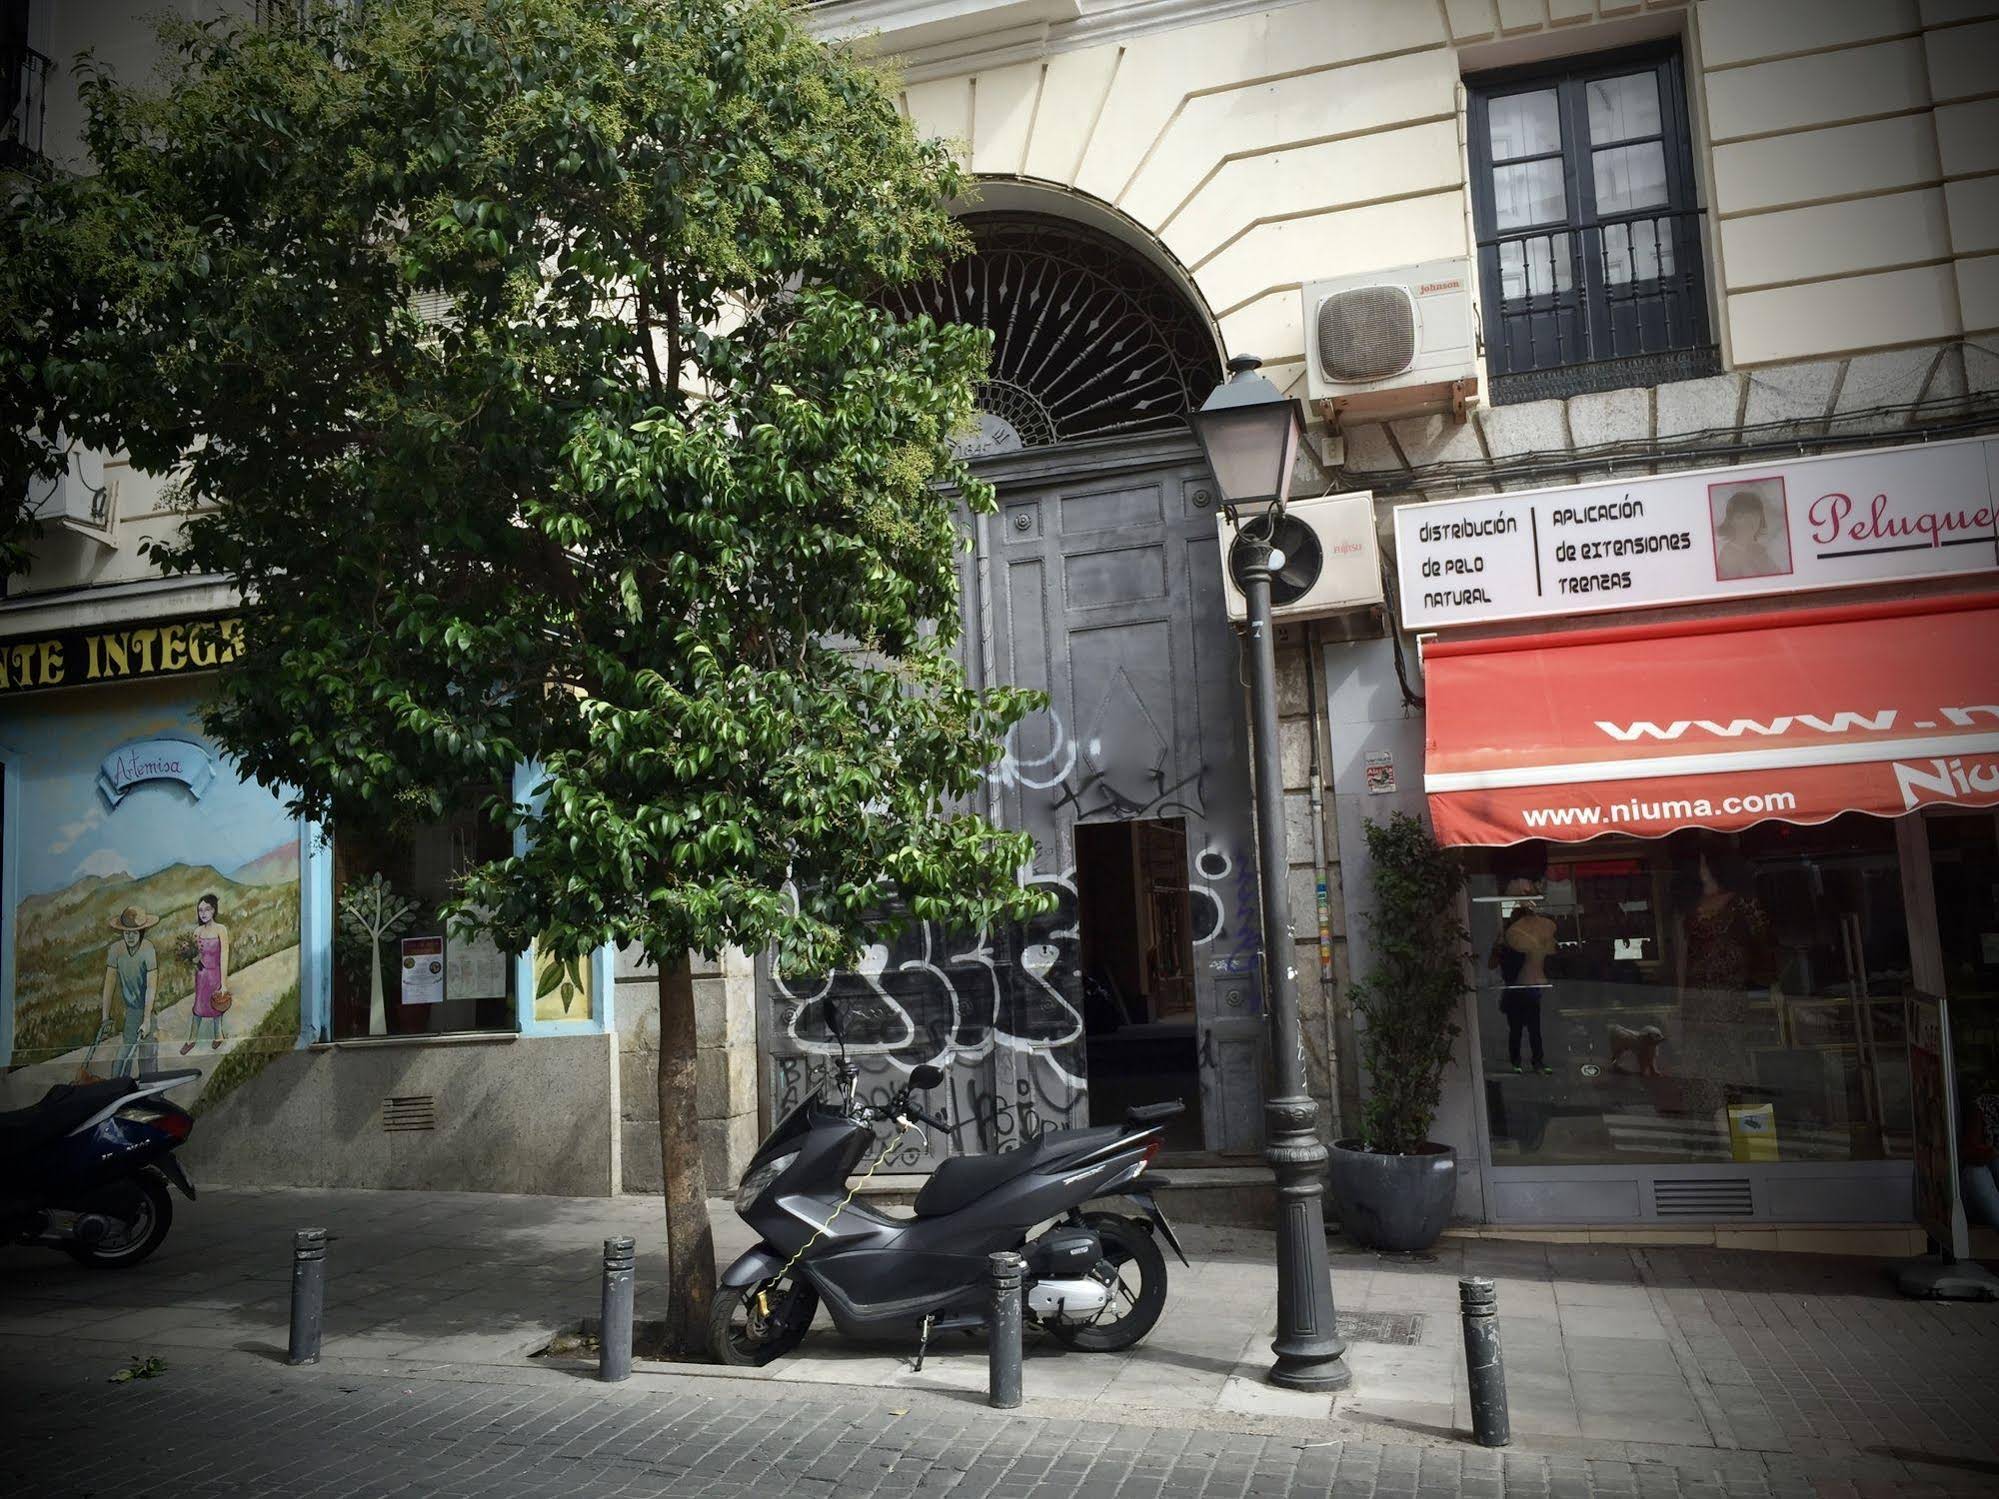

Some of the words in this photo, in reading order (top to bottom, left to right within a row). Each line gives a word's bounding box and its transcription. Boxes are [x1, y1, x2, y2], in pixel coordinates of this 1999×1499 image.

[1419, 510, 1517, 543] distribución
[1808, 493, 1999, 548] Peluque
[1421, 557, 1441, 578] de
[1556, 541, 1576, 563] de
[114, 749, 183, 785] Artemisa
[1522, 789, 1796, 827] www.niuma.com
